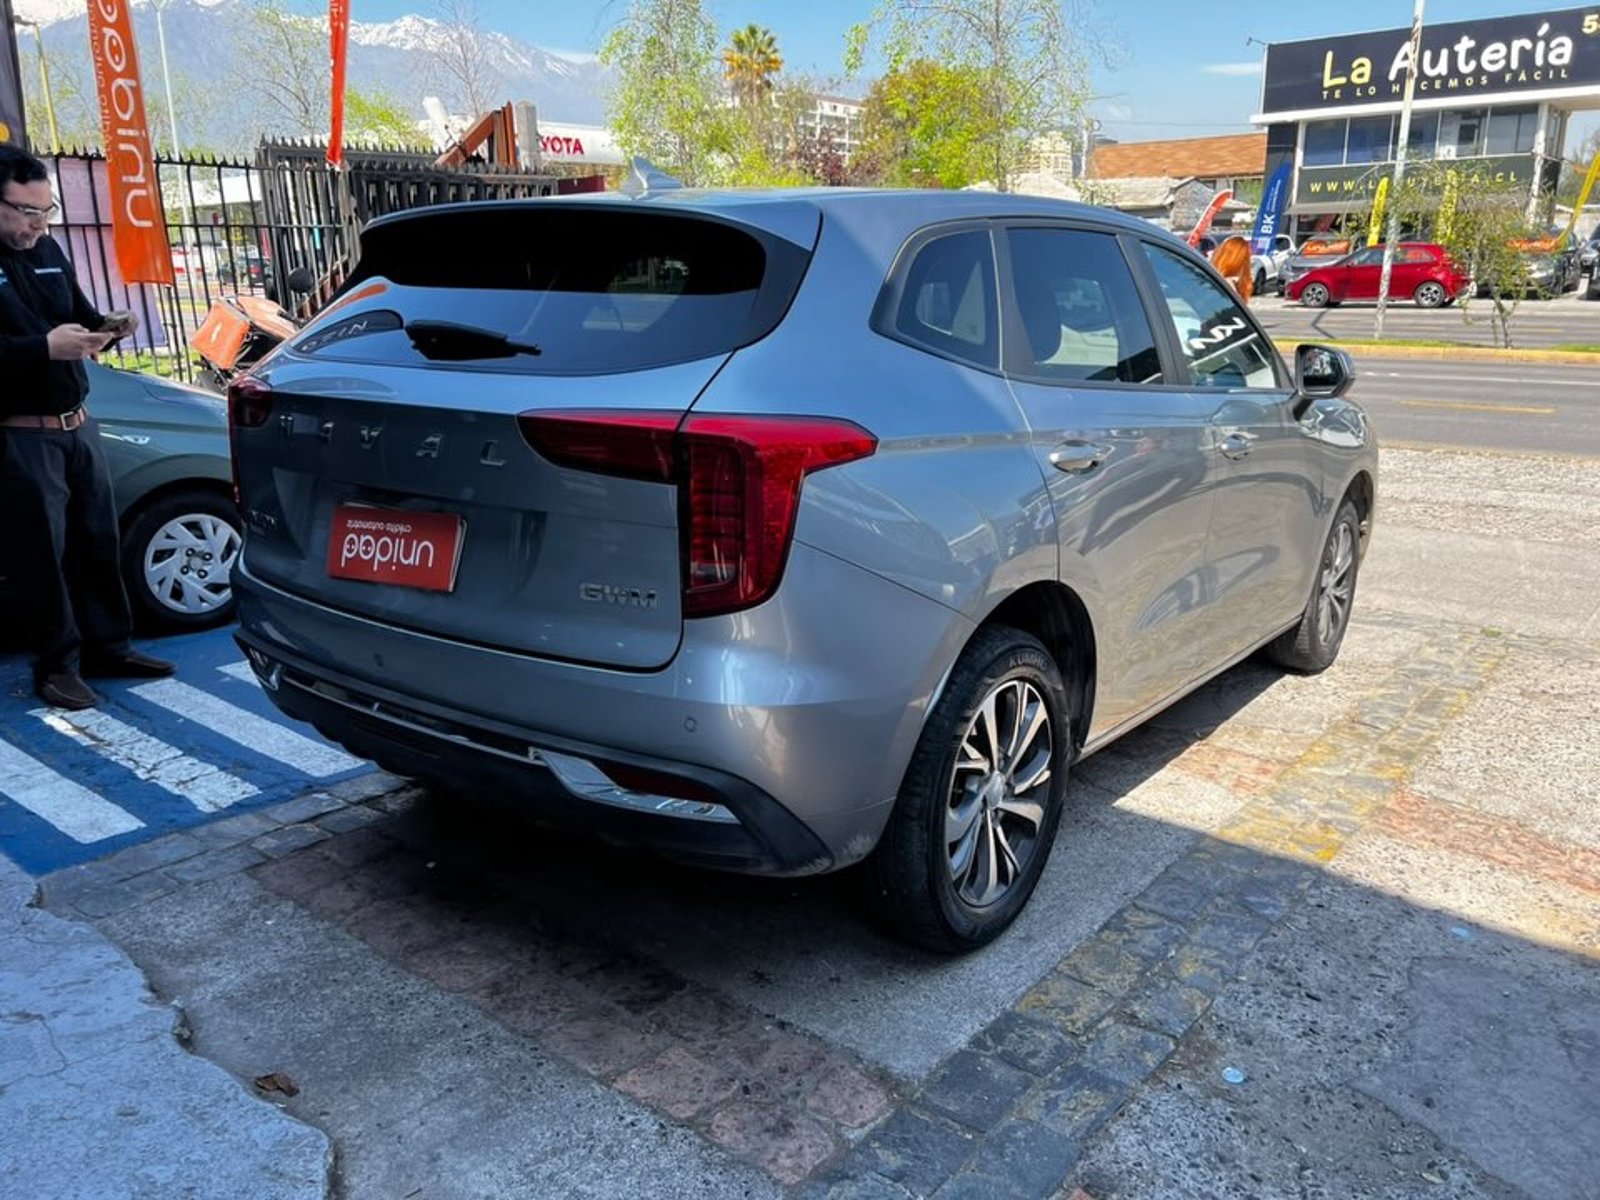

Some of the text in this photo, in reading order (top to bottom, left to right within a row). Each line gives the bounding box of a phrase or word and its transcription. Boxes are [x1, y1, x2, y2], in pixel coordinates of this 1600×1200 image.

[1582, 14, 1600, 35] 5
[1322, 22, 1574, 89] La Autería
[1321, 89, 1341, 100] TE
[1356, 87, 1376, 97] LO
[1391, 75, 1488, 94] HCEMOS
[541, 135, 585, 156] YOTA
[341, 533, 434, 572] unidad
[579, 583, 658, 609] GWM
